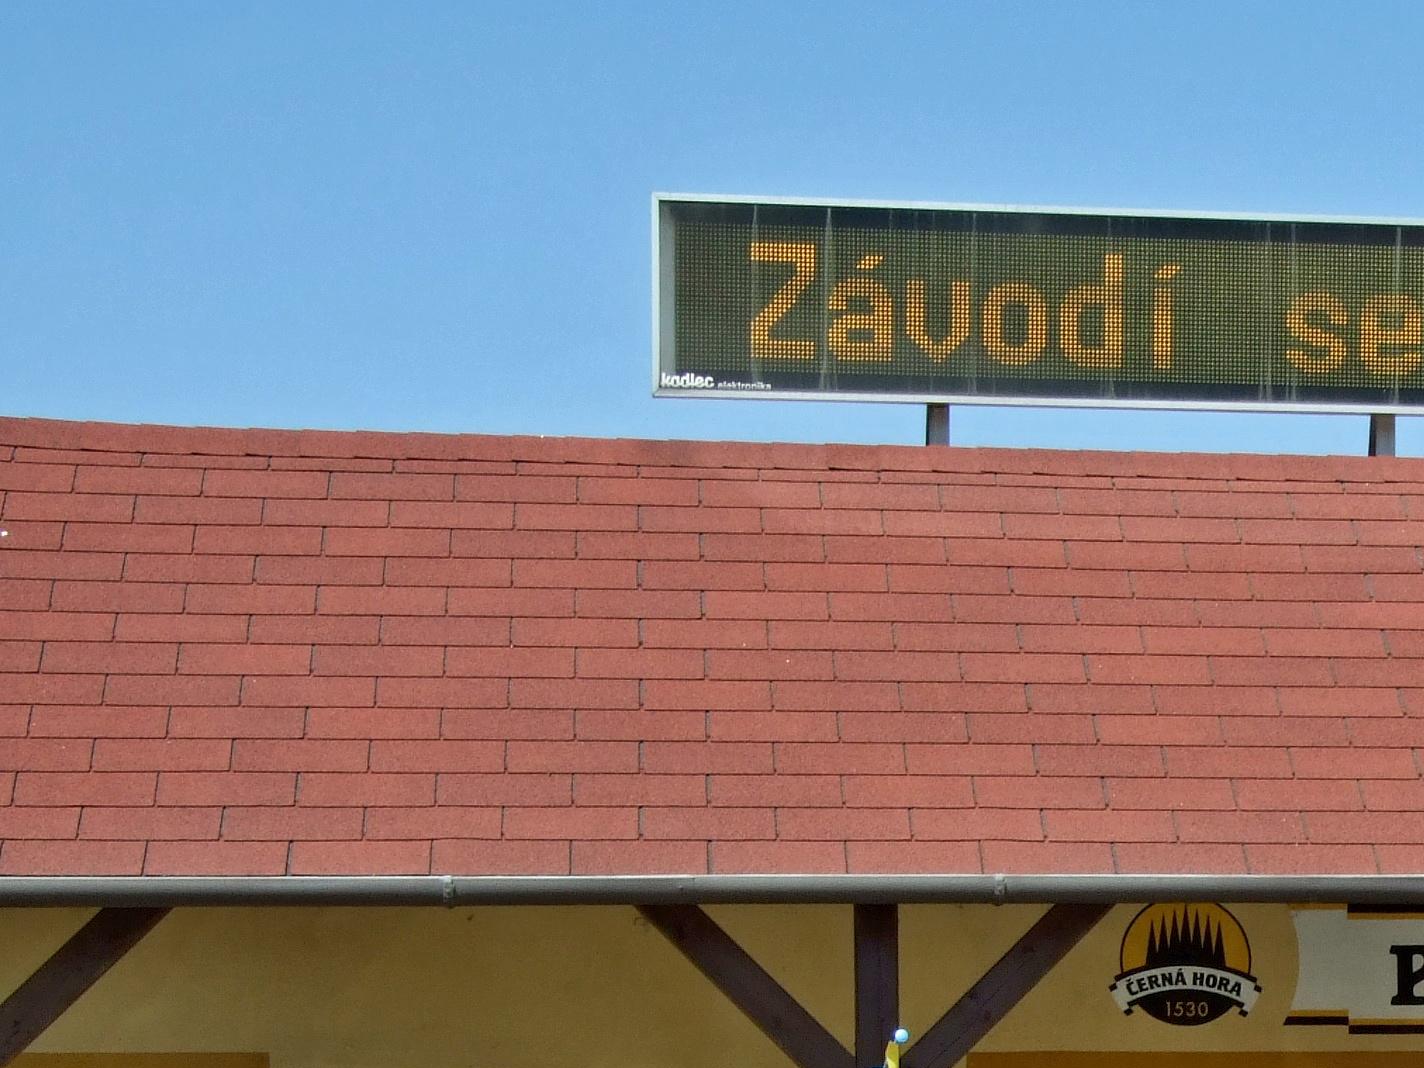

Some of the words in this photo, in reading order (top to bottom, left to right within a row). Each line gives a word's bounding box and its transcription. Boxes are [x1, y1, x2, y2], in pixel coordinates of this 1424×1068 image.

[750, 242, 1181, 370] Závodí
[1286, 292, 1424, 376] se
[661, 373, 715, 388] kadlec
[1126, 968, 1187, 996] ČERNÁ
[1192, 971, 1241, 997] HORA
[1166, 1001, 1208, 1017] 1530
